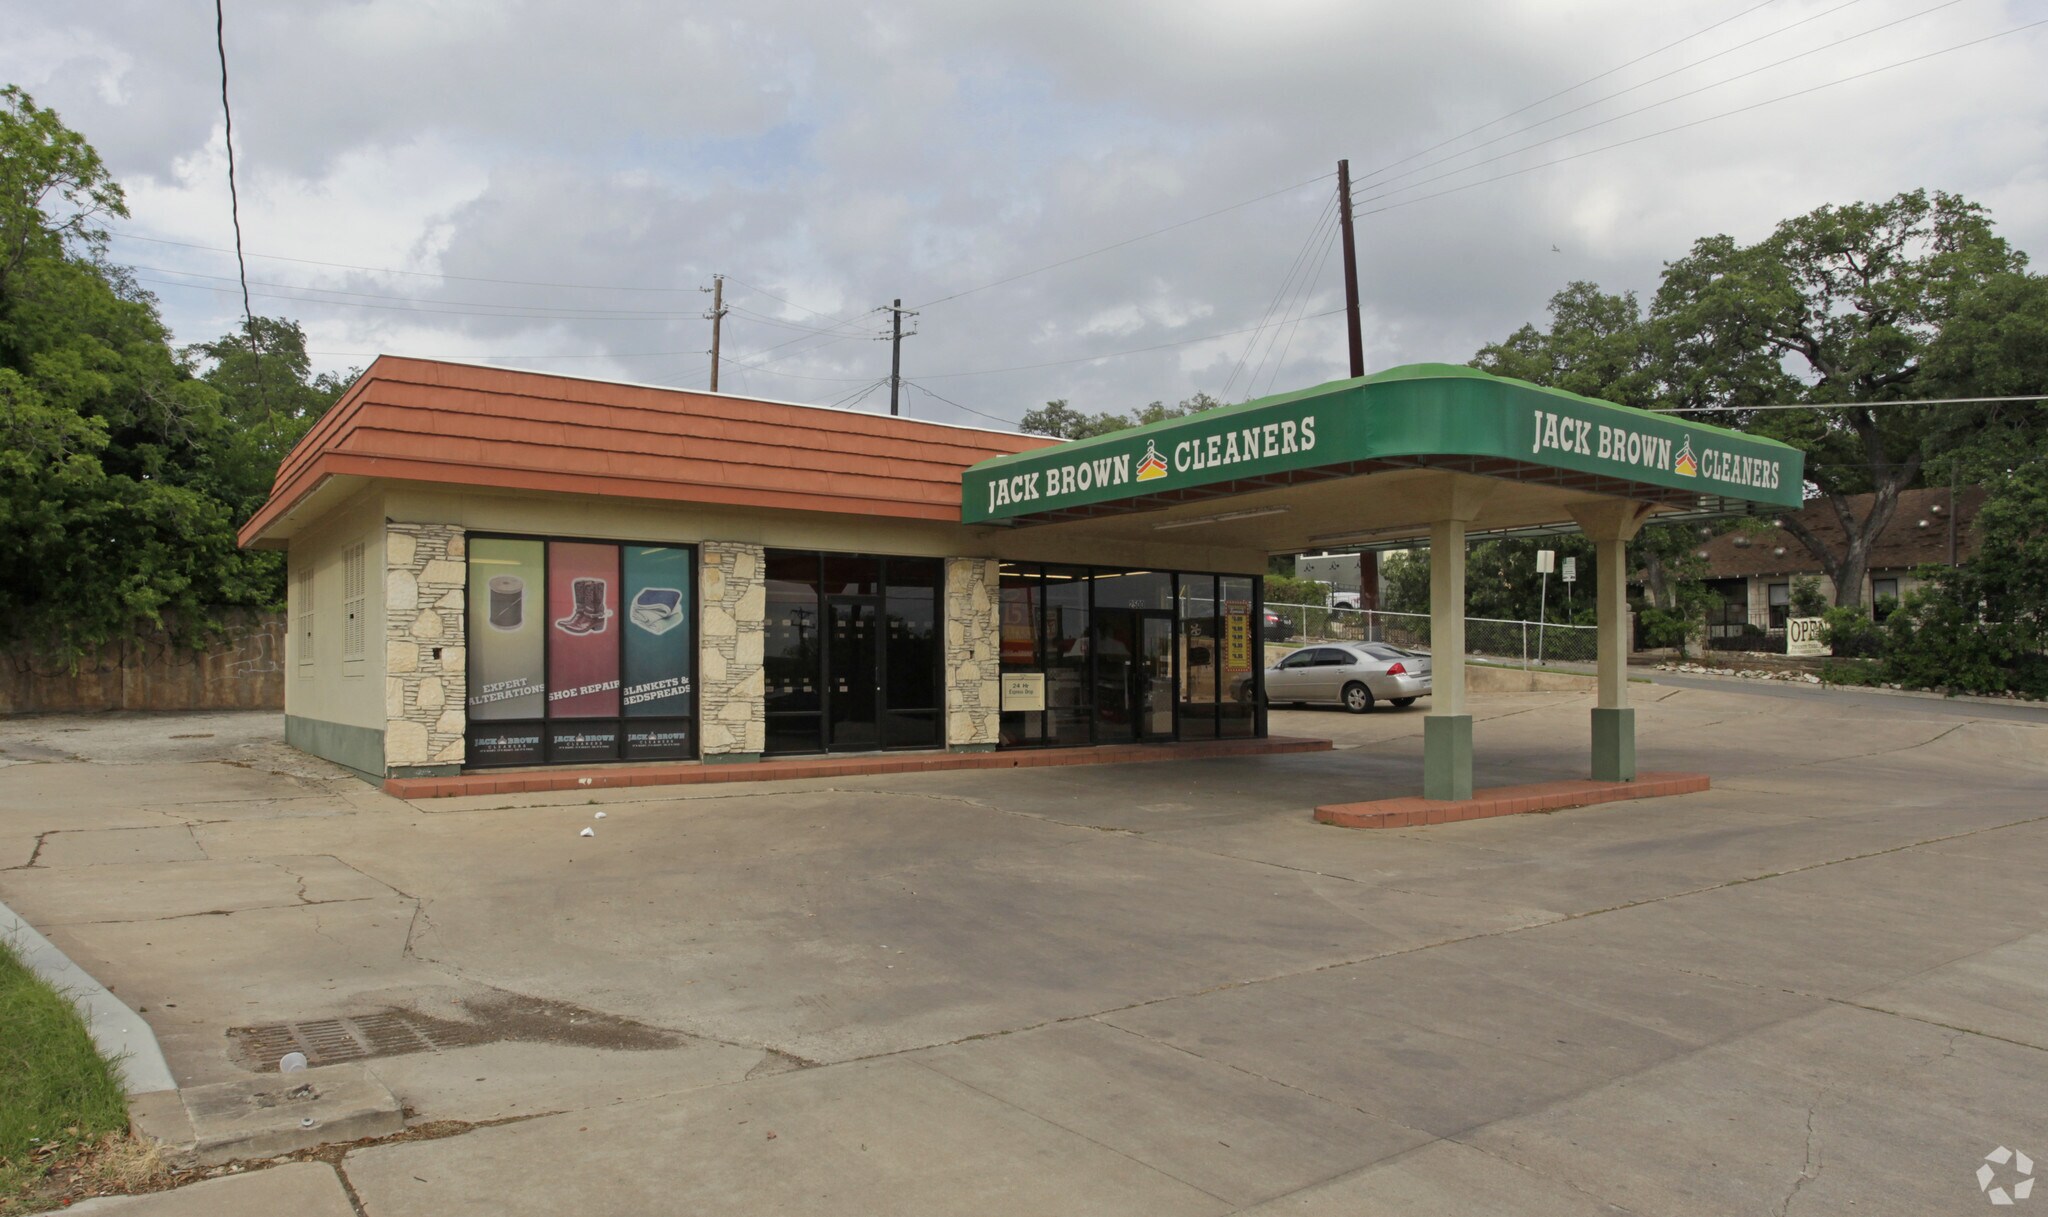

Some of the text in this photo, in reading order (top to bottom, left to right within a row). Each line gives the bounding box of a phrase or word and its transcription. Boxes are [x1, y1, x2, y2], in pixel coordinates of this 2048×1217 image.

[1533, 410, 1779, 489] JACK BROWN CLEANERS
[988, 416, 1316, 514] JACK BROWN CLEANERS
[482, 677, 528, 693] EXPERT
[623, 676, 689, 696] BLANKETS &
[469, 684, 545, 706] ALTERATIONS
[549, 688, 578, 702] SHOE
[623, 684, 691, 706] BEDSPREADS
[474, 736, 539, 747] JACK BROWN
[553, 734, 615, 744] JACK BROWN
[627, 732, 685, 742] JACK BROWN
